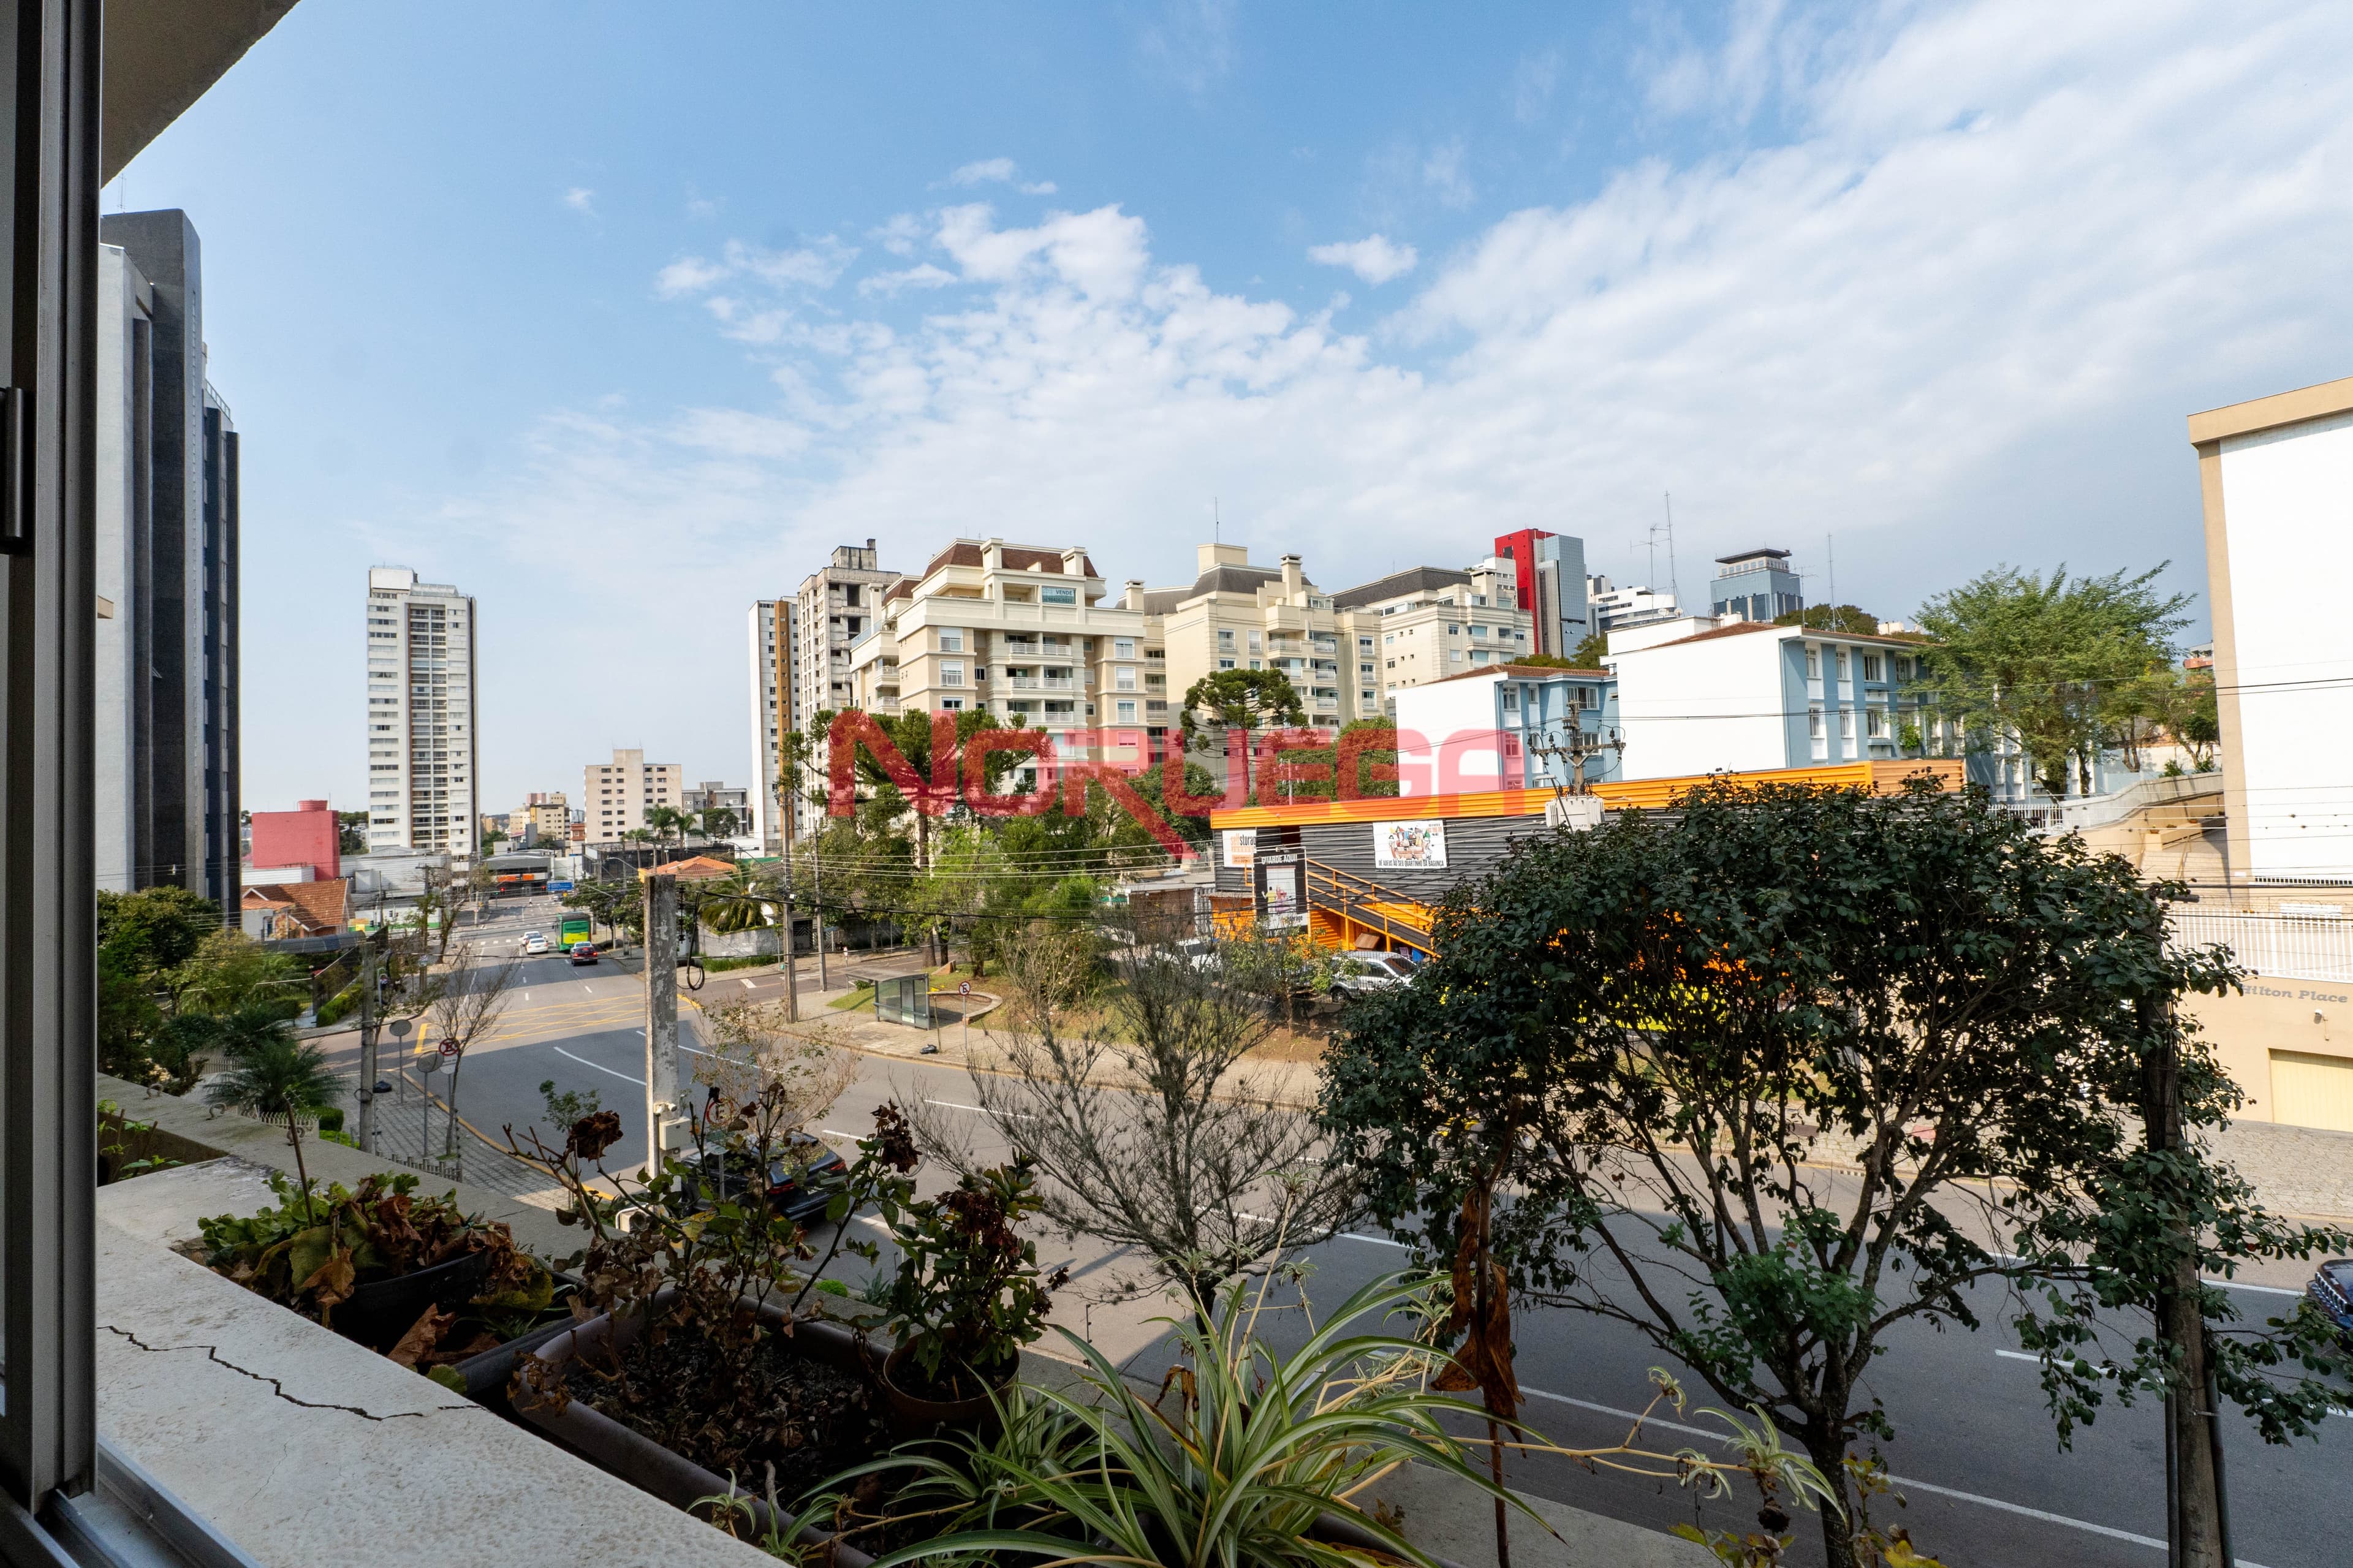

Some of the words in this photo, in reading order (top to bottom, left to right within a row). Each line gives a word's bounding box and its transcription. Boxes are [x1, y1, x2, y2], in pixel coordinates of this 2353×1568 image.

[1261, 855, 1283, 865] GUARDE
[2241, 985, 2292, 998] Hilton
[2297, 990, 2348, 1003] Place
